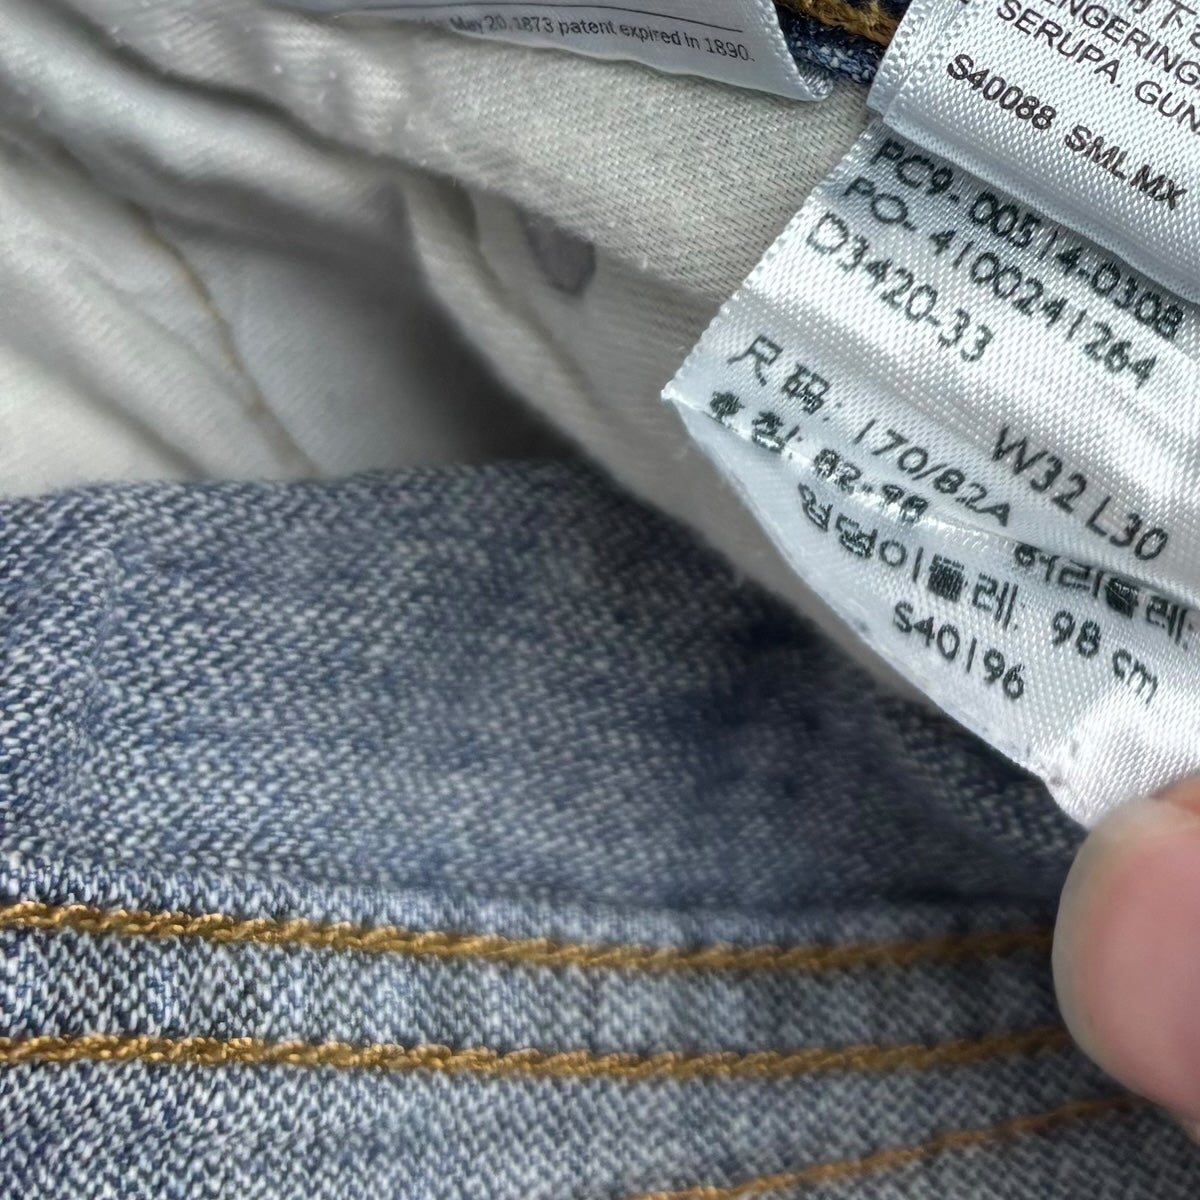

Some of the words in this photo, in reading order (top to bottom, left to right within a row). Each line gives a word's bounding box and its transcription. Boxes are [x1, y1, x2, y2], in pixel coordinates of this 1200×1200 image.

[559, 19, 617, 40] patent
[620, 24, 682, 46] expired
[684, 32, 701, 49] in
[704, 38, 755, 62] 1890.
[946, 53, 1057, 130] S40088
[807, 210, 994, 363] D3420-33
[855, 418, 1011, 528] 170/82A
[992, 424, 1089, 514] W32
[1085, 496, 1170, 563] L30
[893, 602, 1025, 700] S40196
[1051, 609, 1103, 659] 98
[1109, 647, 1160, 704] cm
